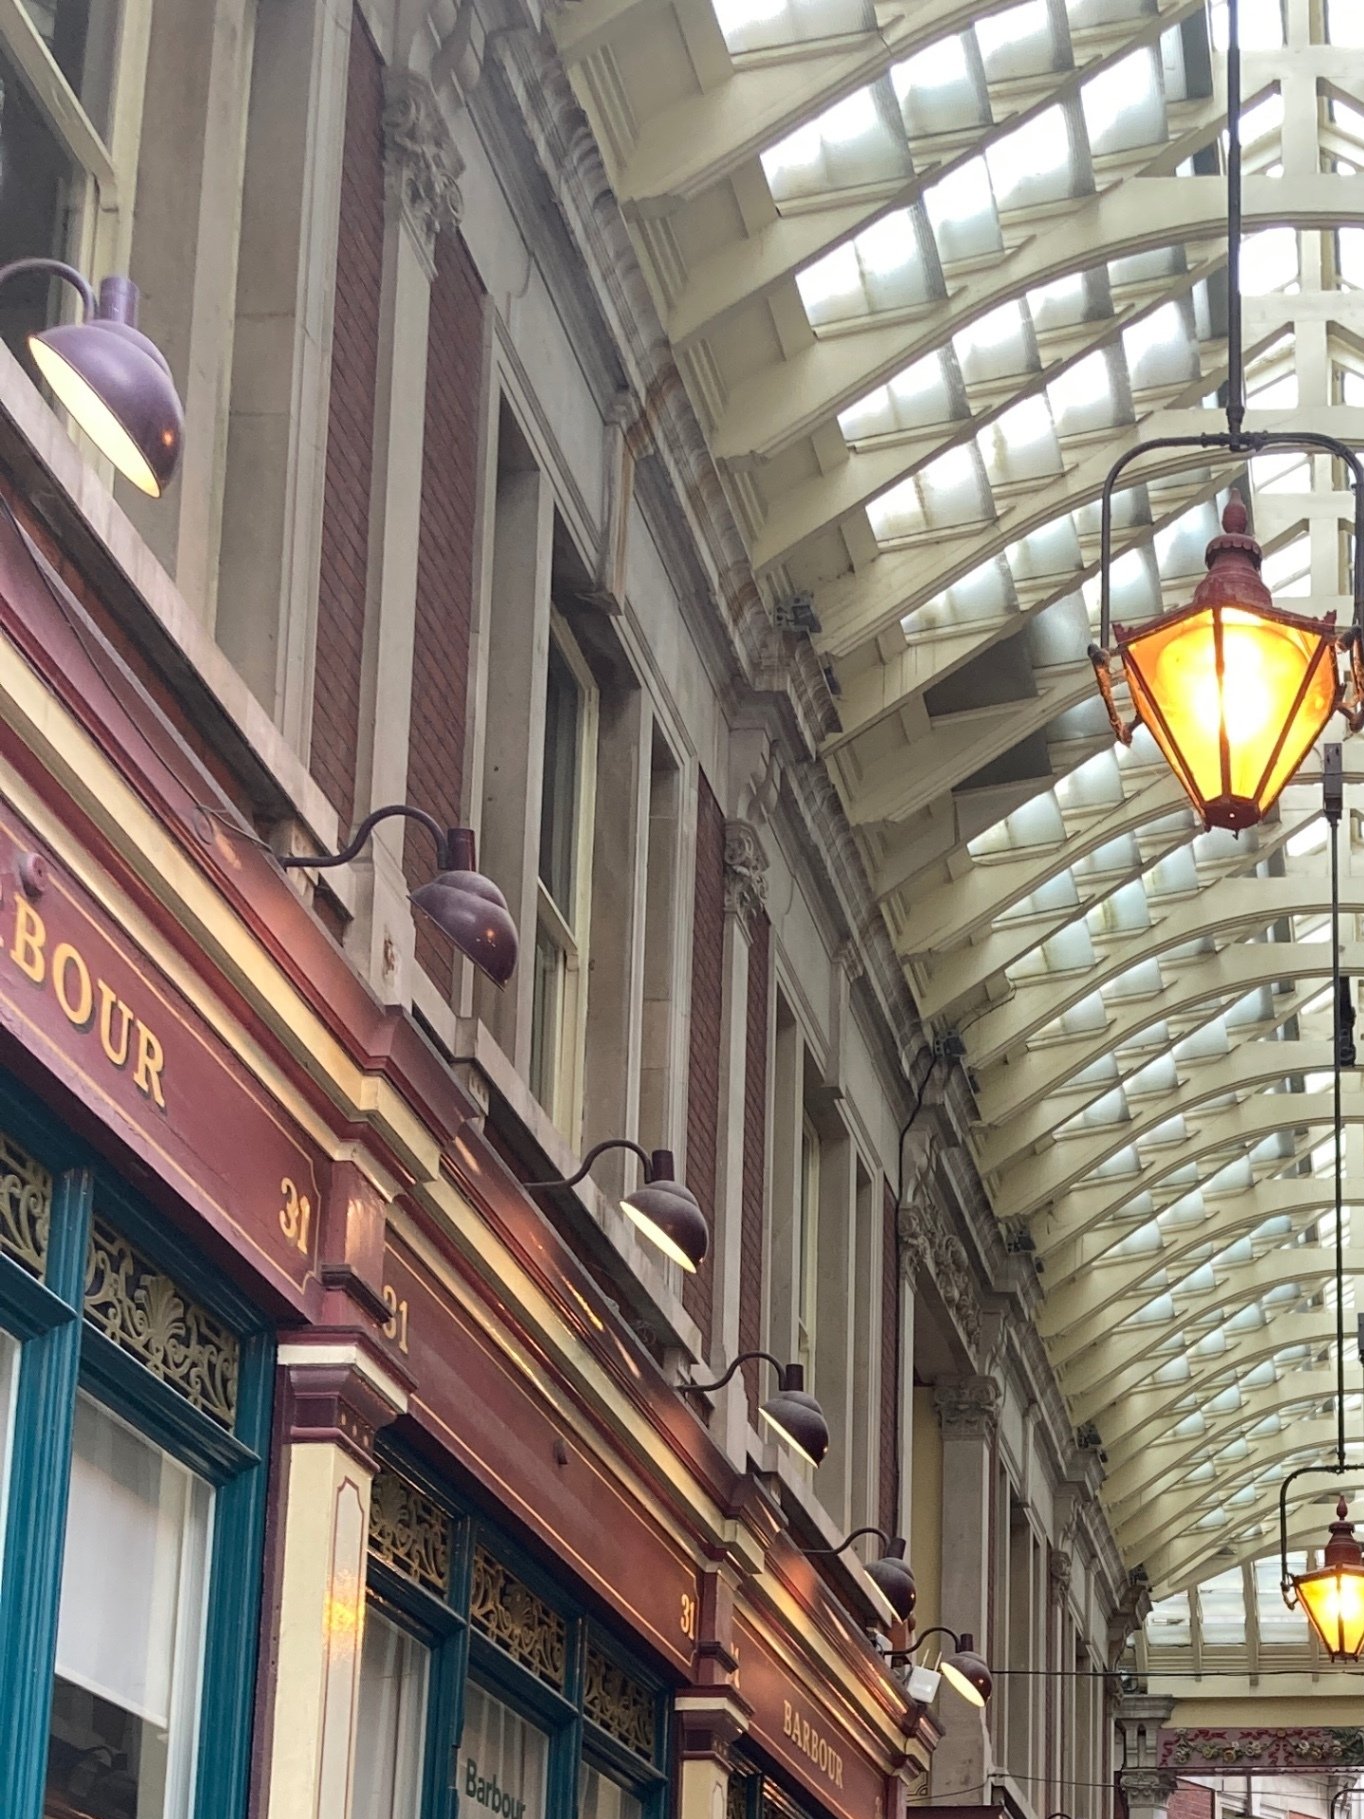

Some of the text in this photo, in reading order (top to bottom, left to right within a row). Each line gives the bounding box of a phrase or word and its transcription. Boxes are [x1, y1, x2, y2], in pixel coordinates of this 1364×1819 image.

[0, 889, 165, 1109] BOUR
[279, 1176, 311, 1255] 31
[383, 1284, 408, 1355] 31
[680, 1593, 695, 1640] 31
[782, 1699, 844, 1789] BARBOUR
